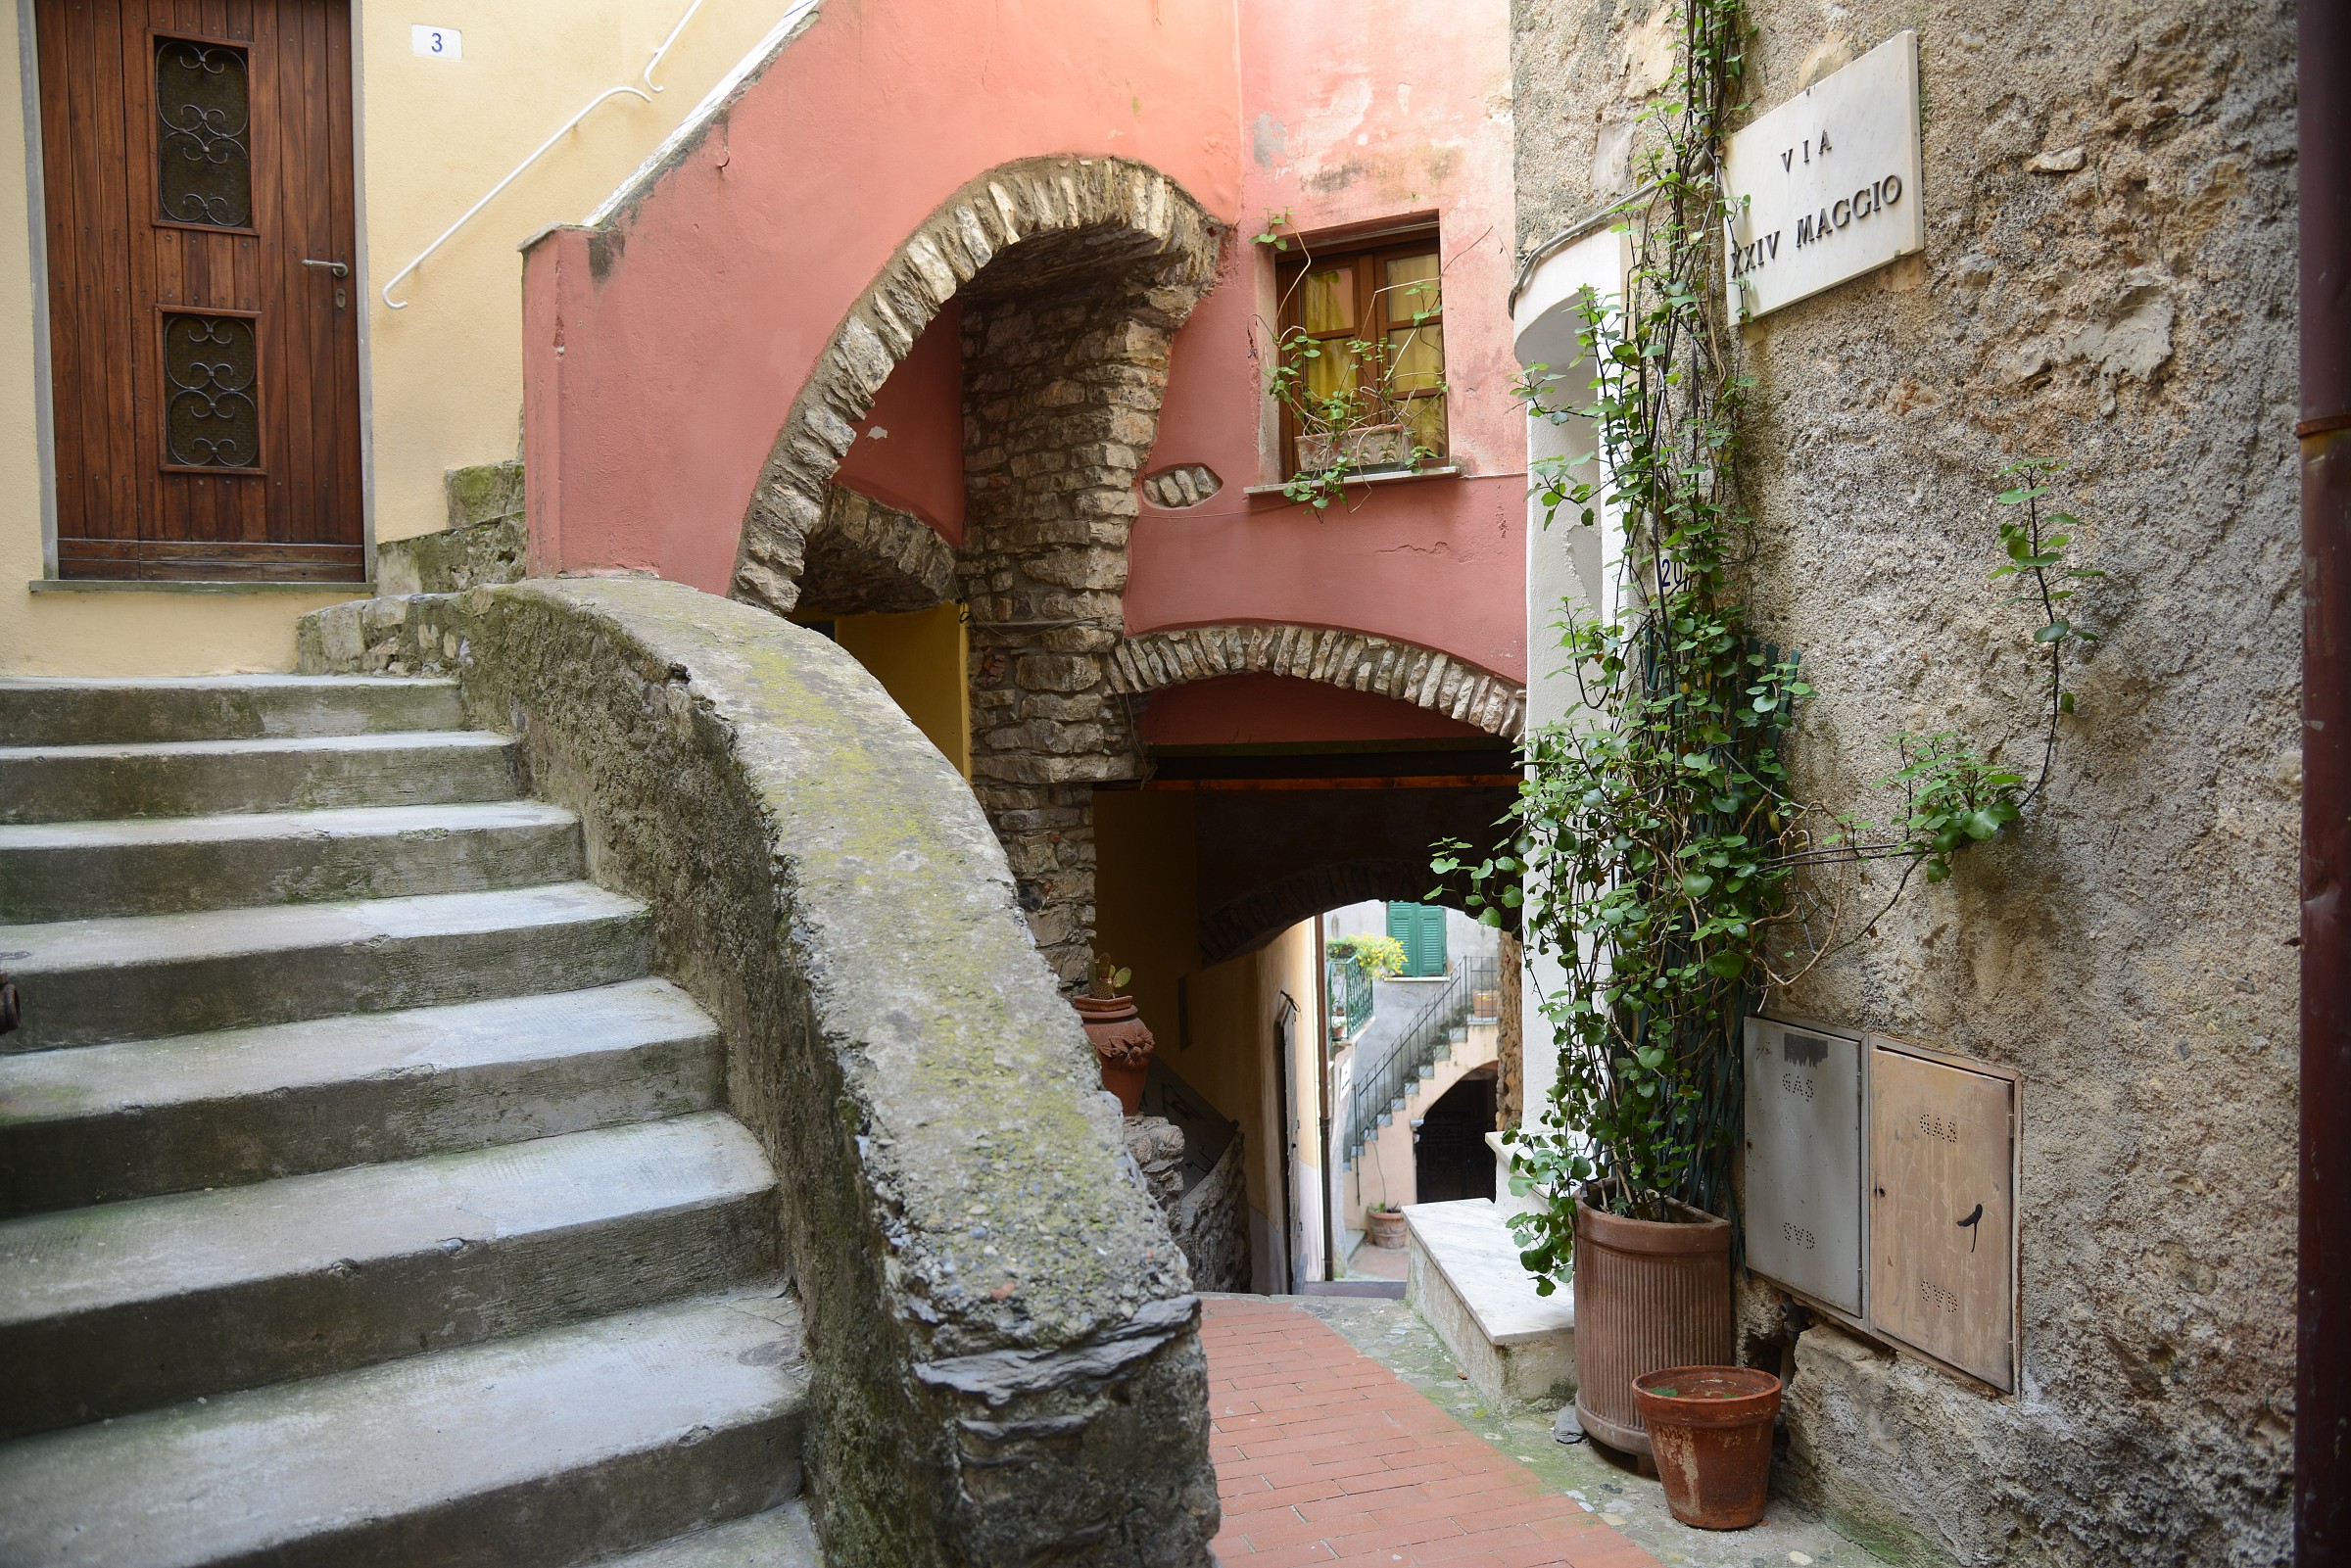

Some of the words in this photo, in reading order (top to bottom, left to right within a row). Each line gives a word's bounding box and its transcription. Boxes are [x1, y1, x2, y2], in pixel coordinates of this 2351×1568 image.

[431, 32, 443, 53] 3
[1780, 128, 1833, 173] VIA
[1730, 230, 1781, 279] XXIV
[1796, 174, 1903, 249] MAGGIO
[1661, 558, 1682, 587] 20
[1782, 1072, 1814, 1100] GAS
[1919, 1114, 1957, 1144] GAS
